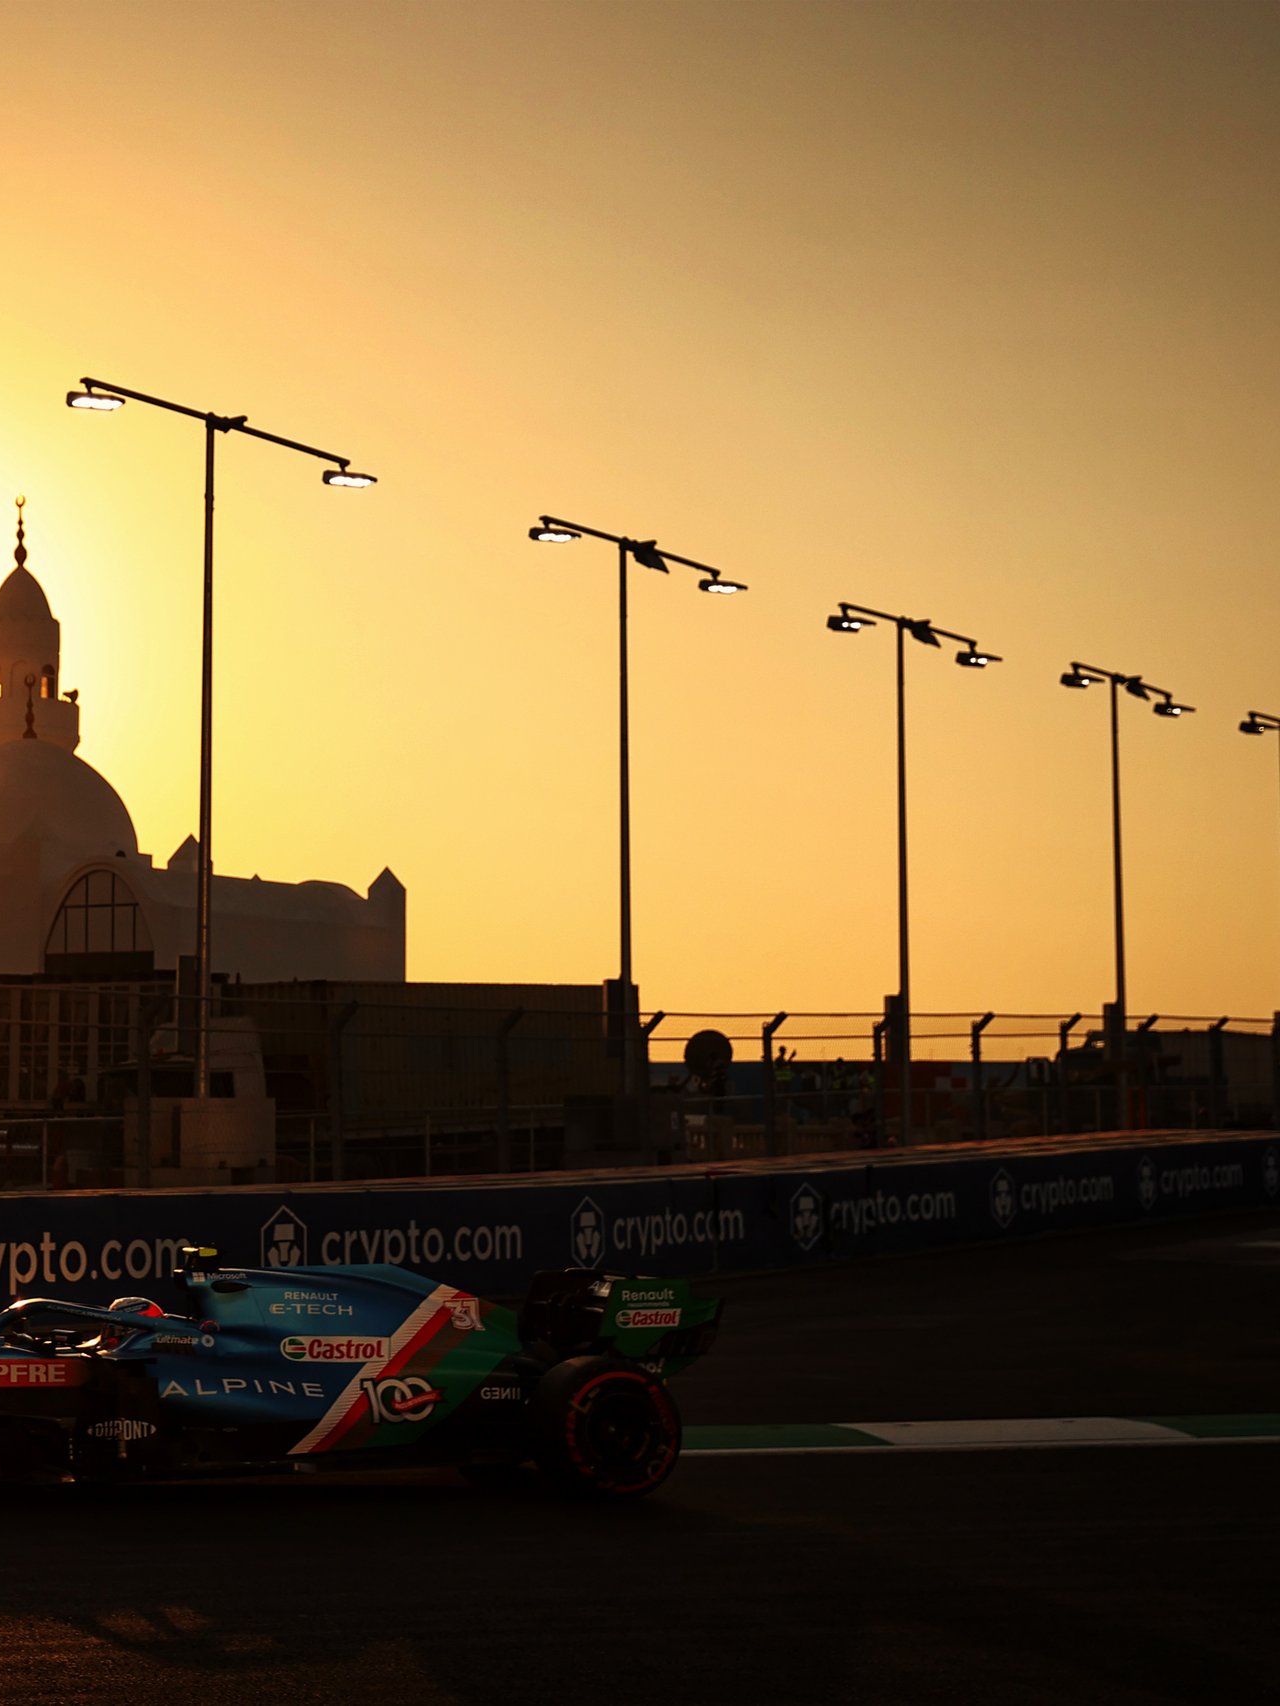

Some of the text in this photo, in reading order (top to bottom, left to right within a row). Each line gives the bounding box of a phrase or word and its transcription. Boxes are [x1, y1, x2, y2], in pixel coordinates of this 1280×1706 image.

[1160, 1162, 1244, 1199] crypto.com
[1021, 1175, 1113, 1215] crypto.com
[206, 1272, 247, 1280] Microsoft
[284, 1292, 338, 1301] RENAULT
[622, 1288, 675, 1302] Renault
[269, 1304, 353, 1316] E-TECH
[632, 1311, 677, 1326] Castrol
[308, 1339, 384, 1359] Castrol
[160, 1378, 325, 1399] ALPINE
